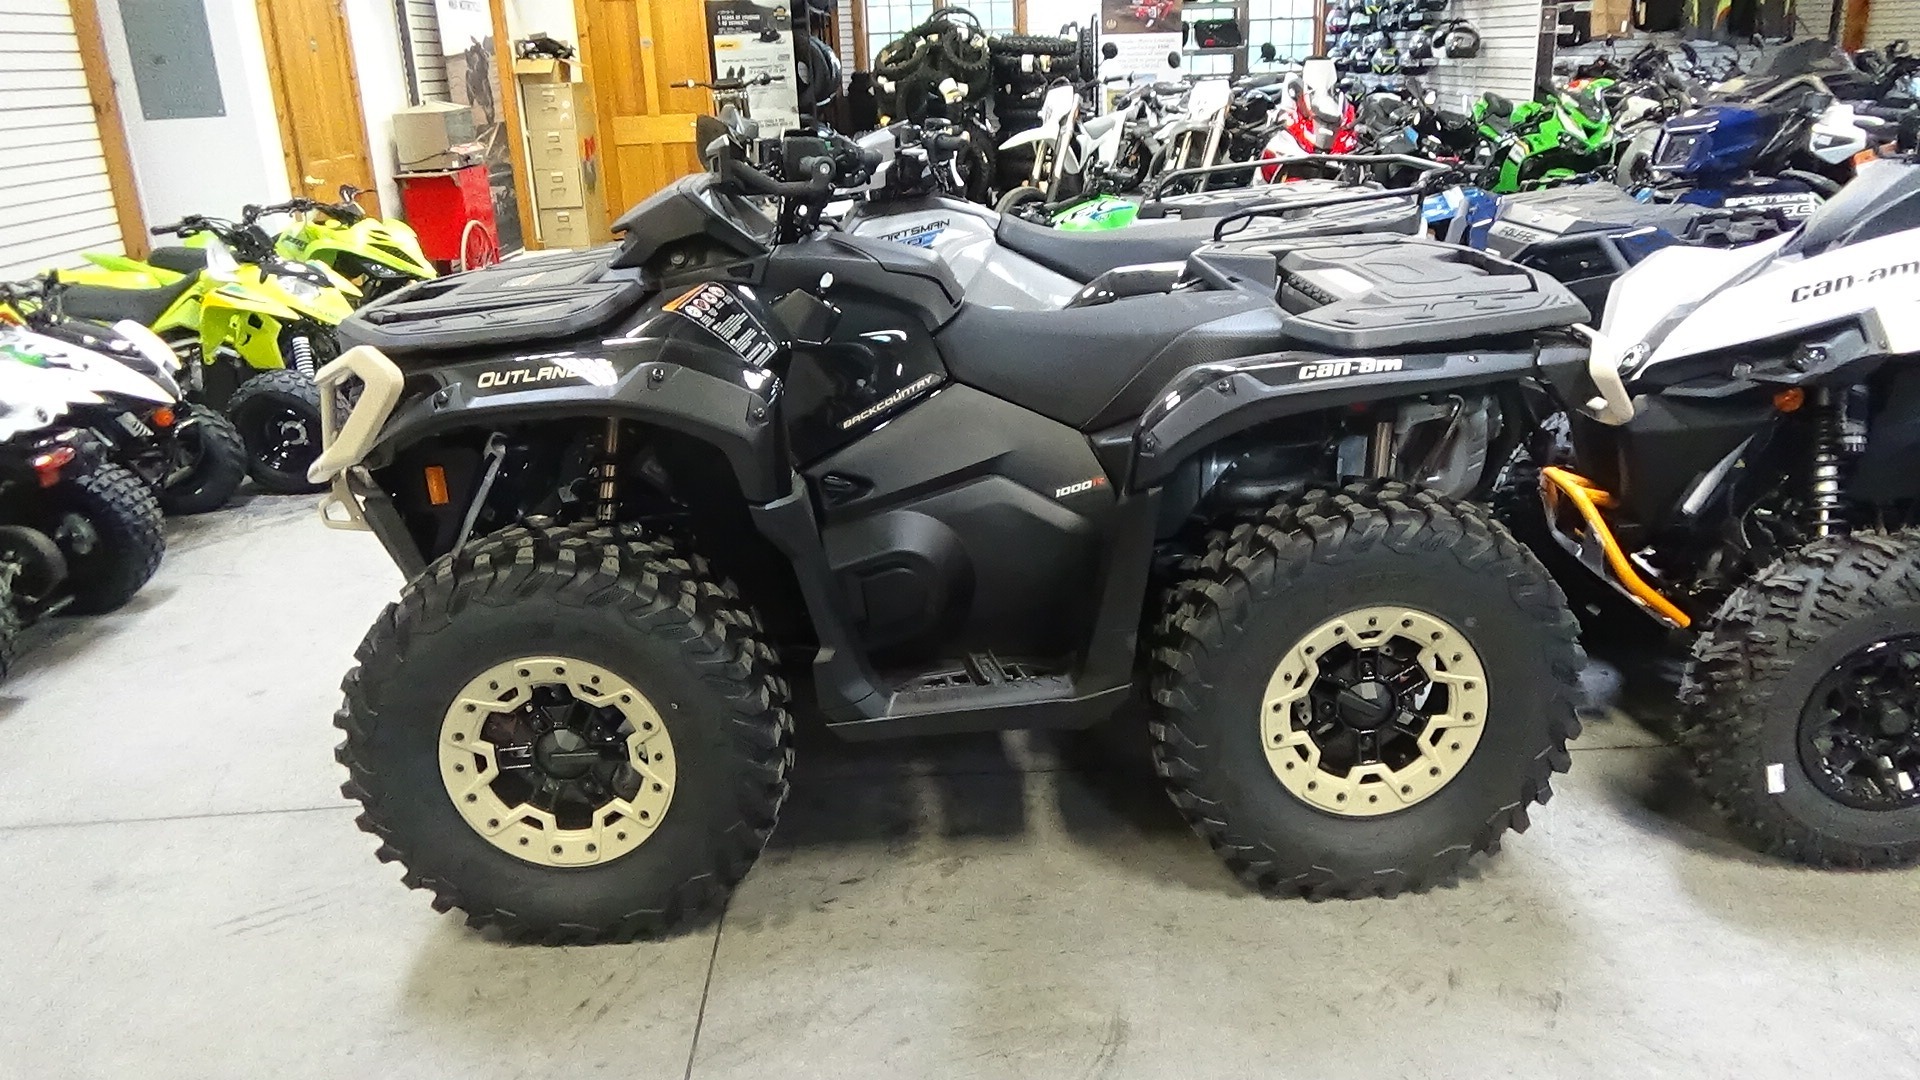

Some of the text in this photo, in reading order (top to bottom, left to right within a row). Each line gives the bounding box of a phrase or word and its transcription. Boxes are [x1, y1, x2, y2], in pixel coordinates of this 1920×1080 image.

[877, 219, 950, 241] ORTSMAN
[1790, 261, 1919, 303] can-am
[1299, 359, 1402, 380] can-am
[843, 375, 932, 429] BACKCOUNTRY
[1055, 477, 1104, 498] 1000R
